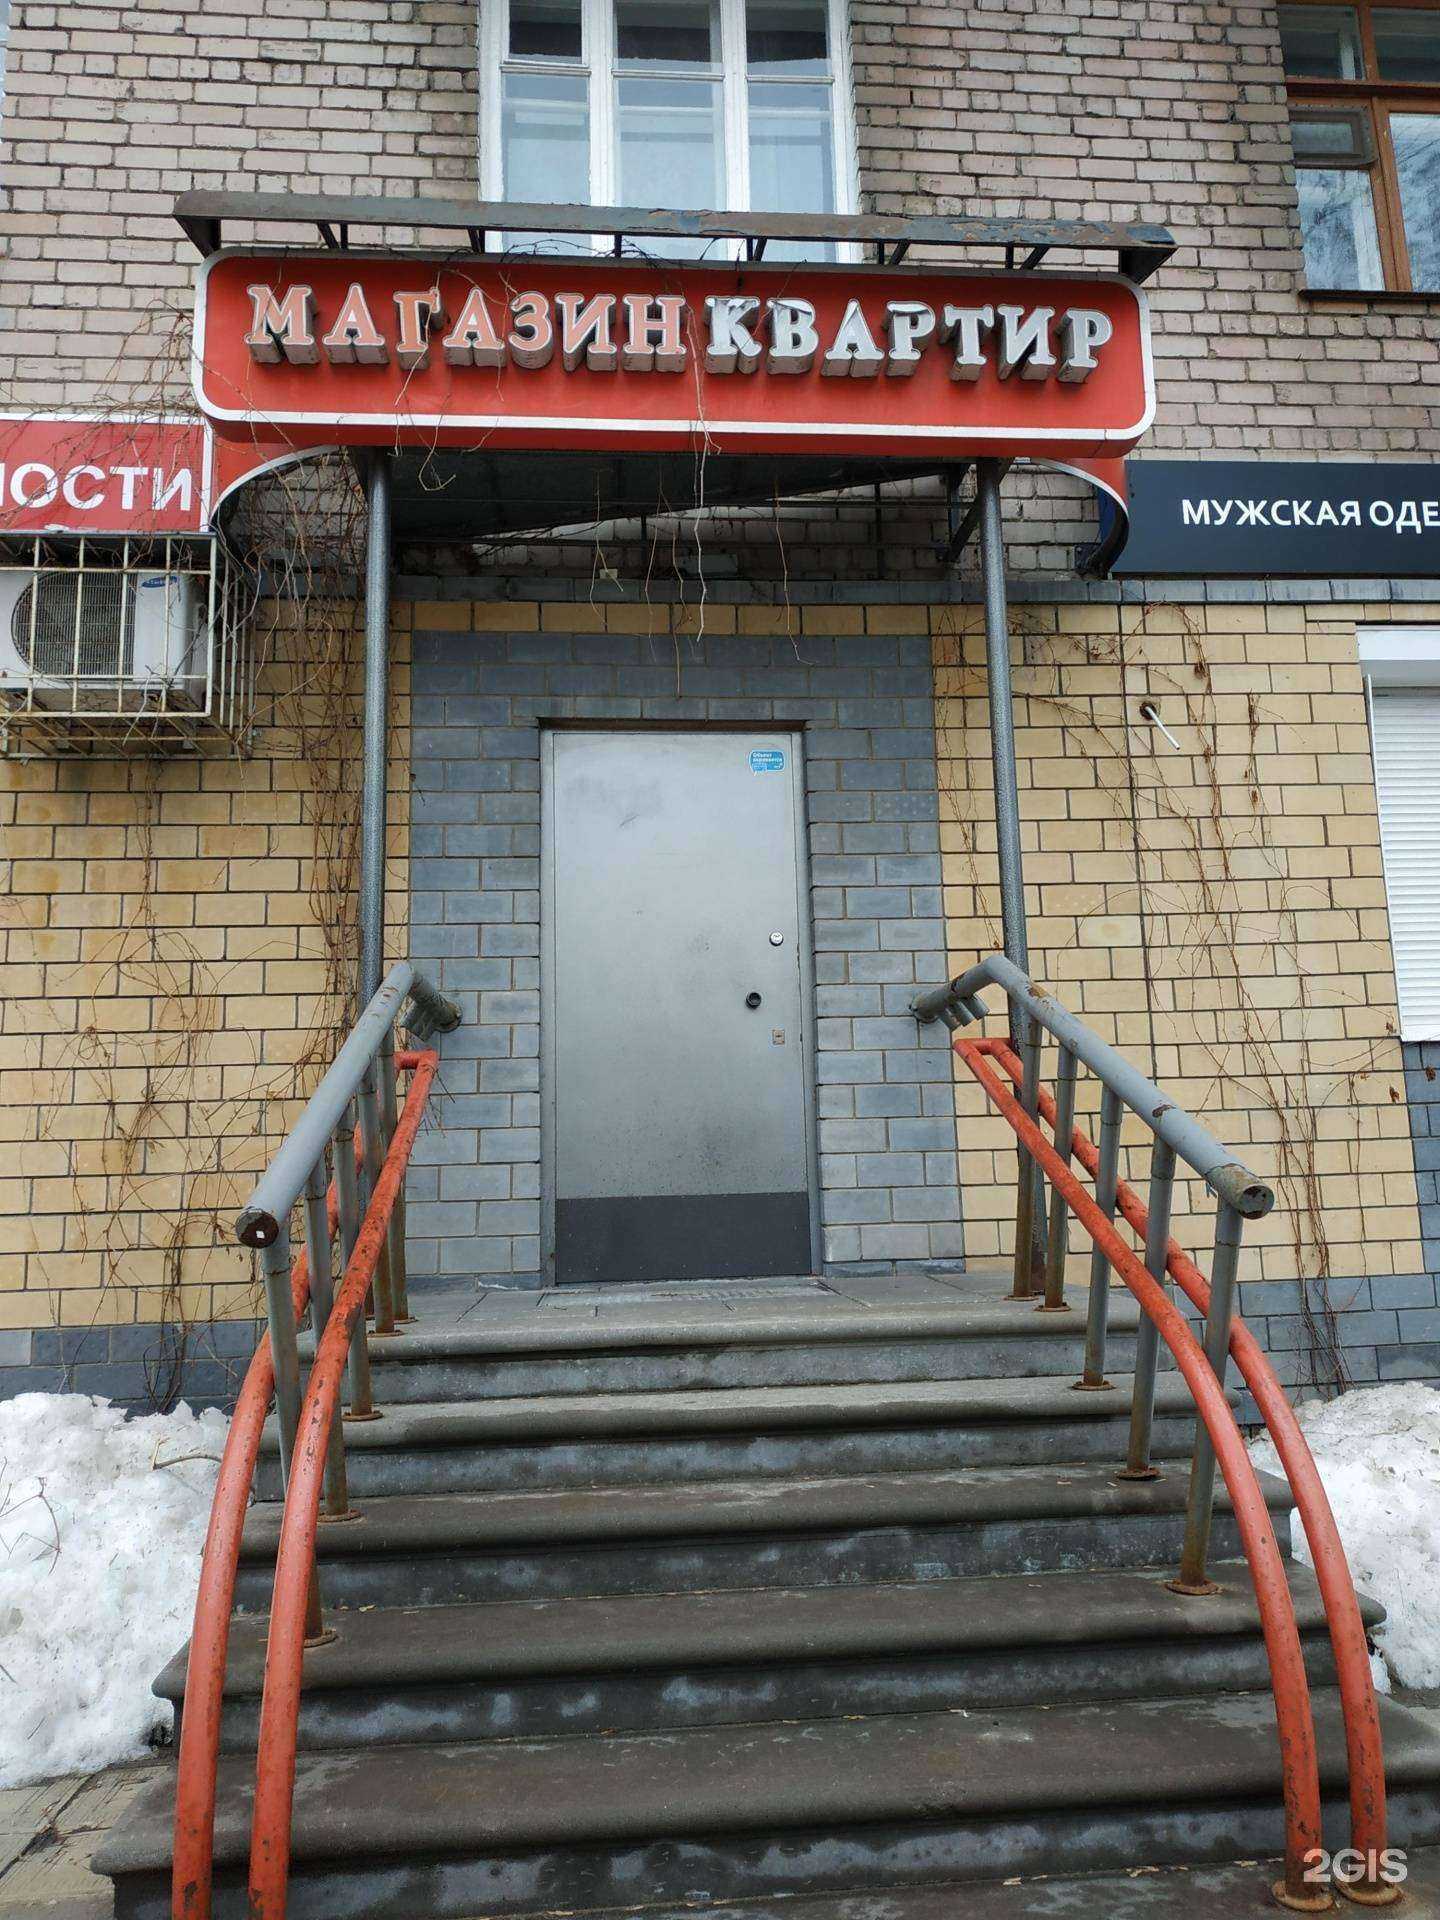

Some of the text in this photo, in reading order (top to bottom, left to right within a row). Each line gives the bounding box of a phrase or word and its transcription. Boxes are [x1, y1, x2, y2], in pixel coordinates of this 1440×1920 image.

[243, 281, 1114, 372] МАГАЗИН КВАРТИР
[0, 461, 193, 512] ОСТИ
[1181, 498, 1440, 534] МУЖСКАЯ ОДЕ
